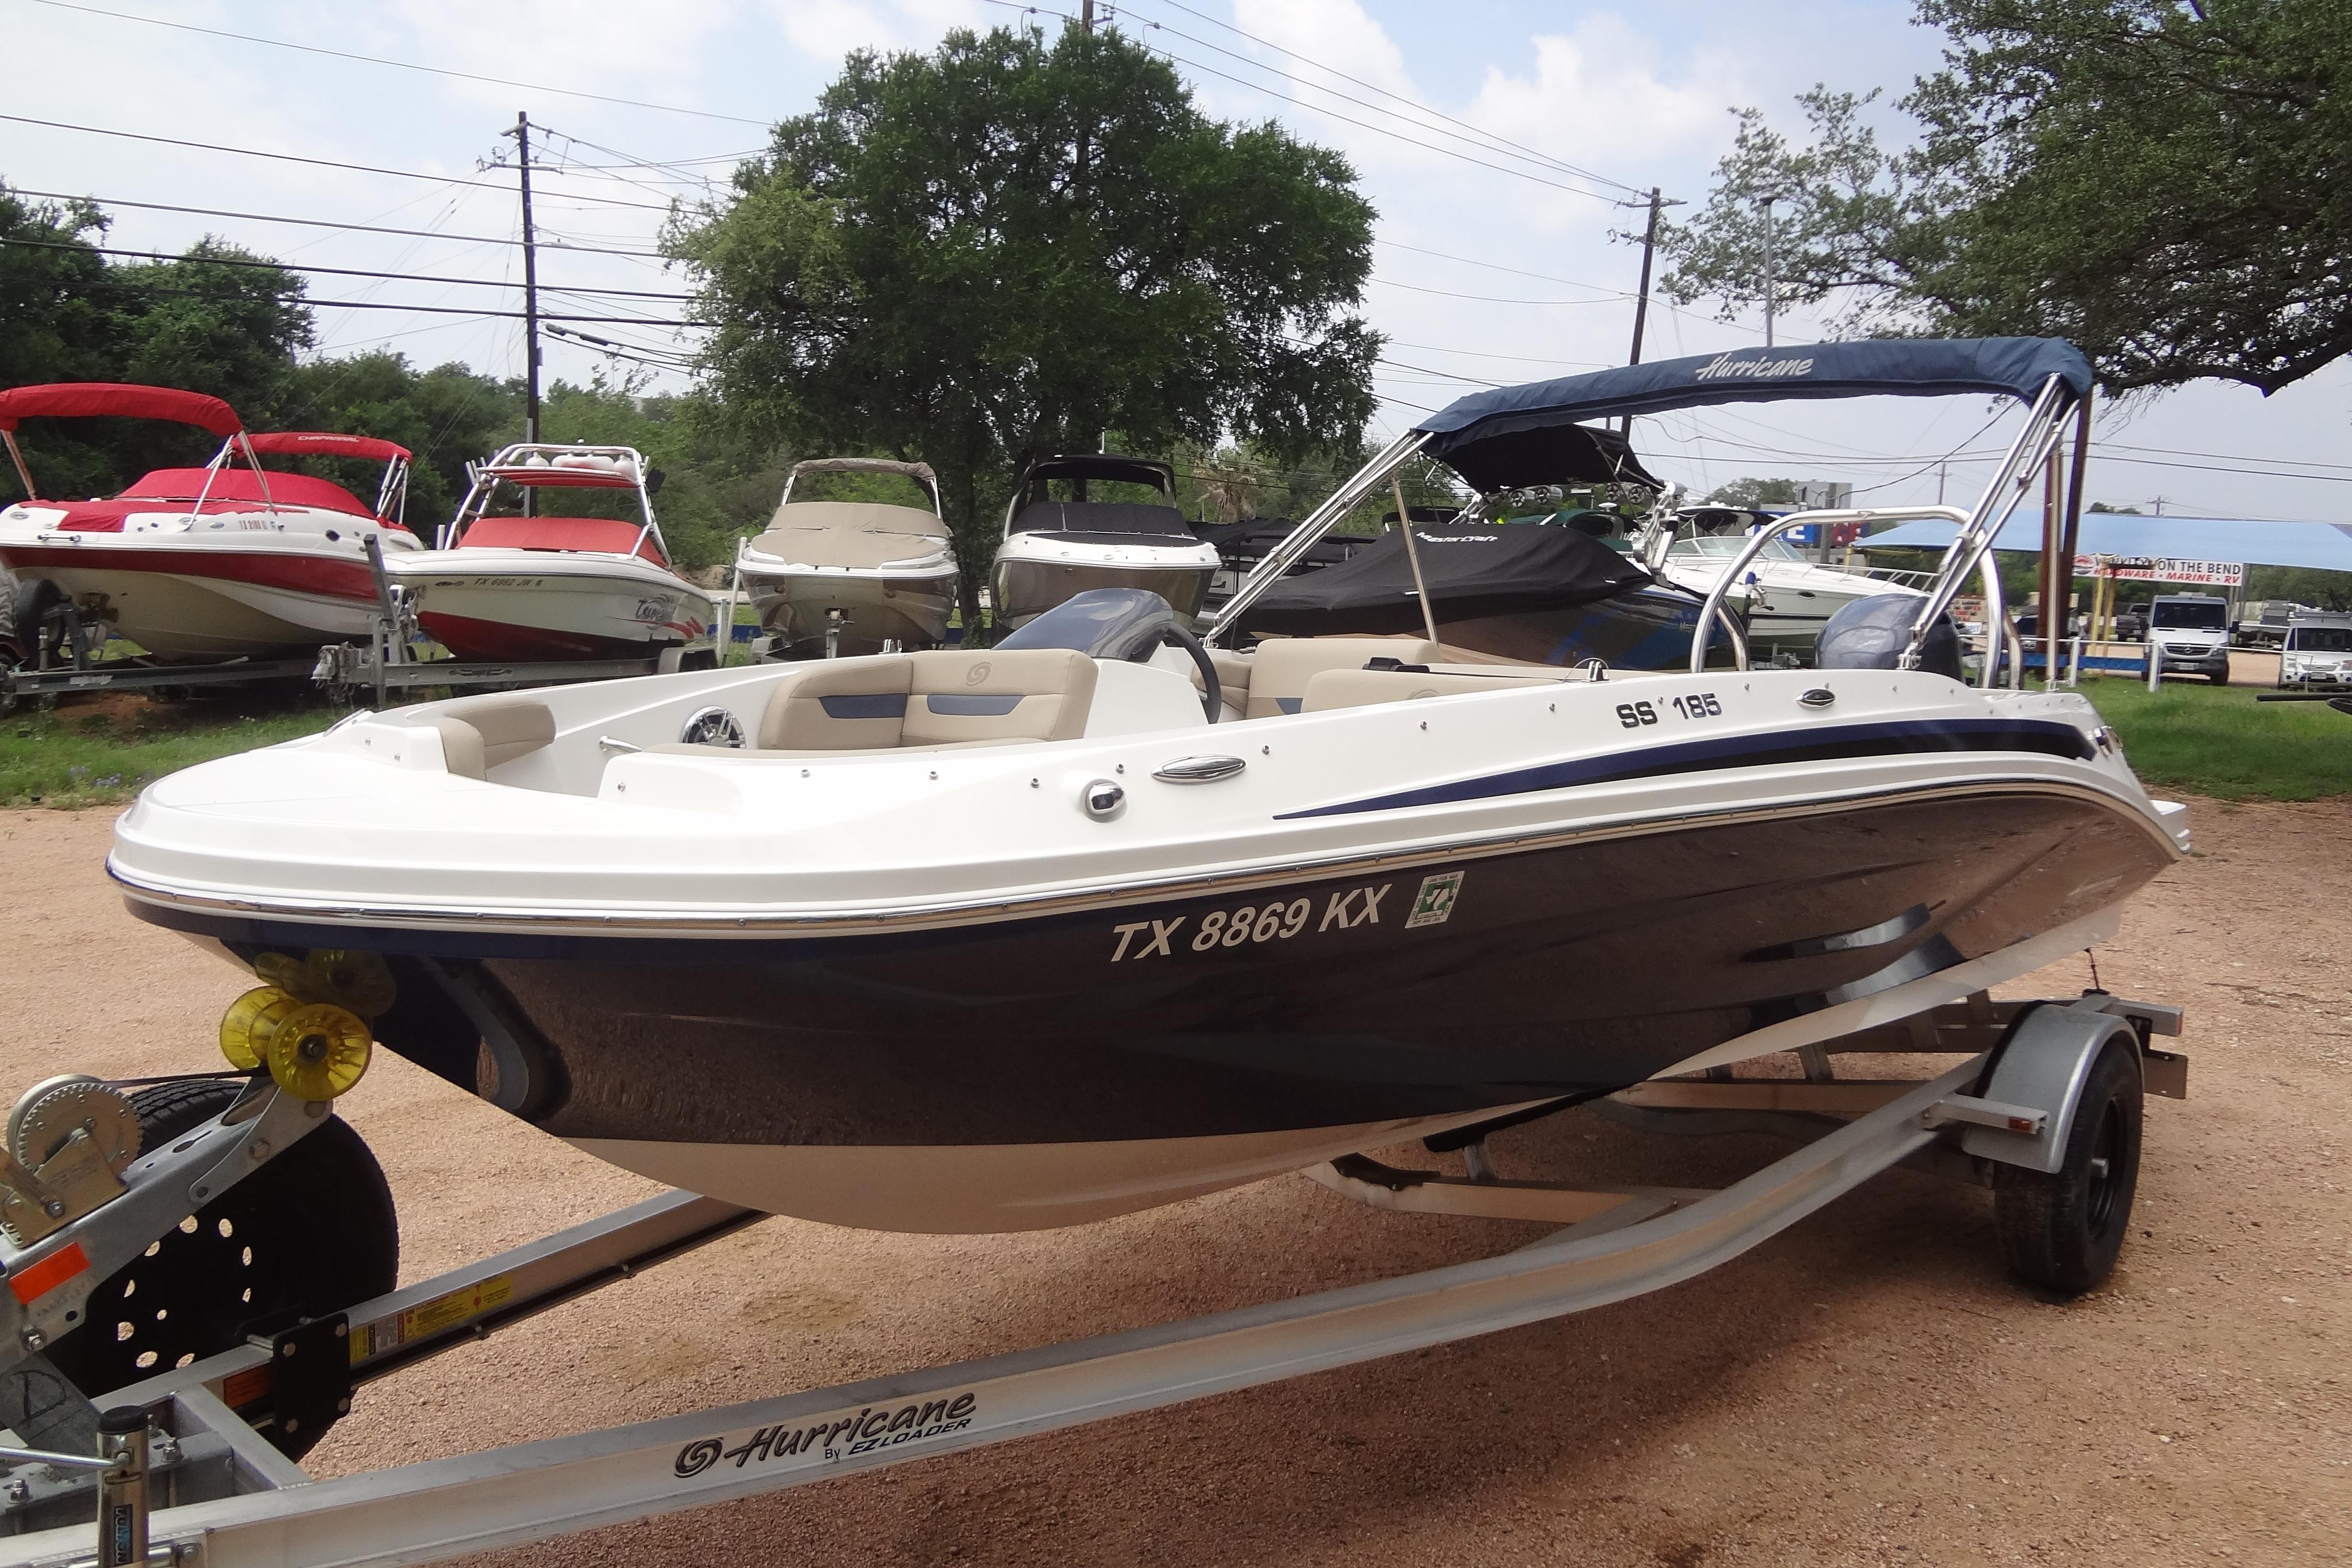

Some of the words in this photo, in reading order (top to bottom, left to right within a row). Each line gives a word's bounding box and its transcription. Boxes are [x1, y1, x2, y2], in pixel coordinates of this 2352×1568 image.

[1696, 353, 1814, 380] Hurricane
[1416, 532, 1498, 543] MasterCraft
[2158, 560, 2175, 571] ON
[2180, 561, 2202, 573] THE
[2208, 563, 2241, 574] BEND
[2166, 572, 2213, 582] MARINE
[2224, 575, 2240, 583] RV
[1615, 701, 1658, 728] SS
[1673, 693, 1722, 720] 185
[1111, 916, 1186, 962] TX
[1192, 898, 1311, 951] 8869
[1318, 884, 1393, 932] KX
[724, 1393, 976, 1467] Hurricane
[825, 1448, 841, 1460] By
